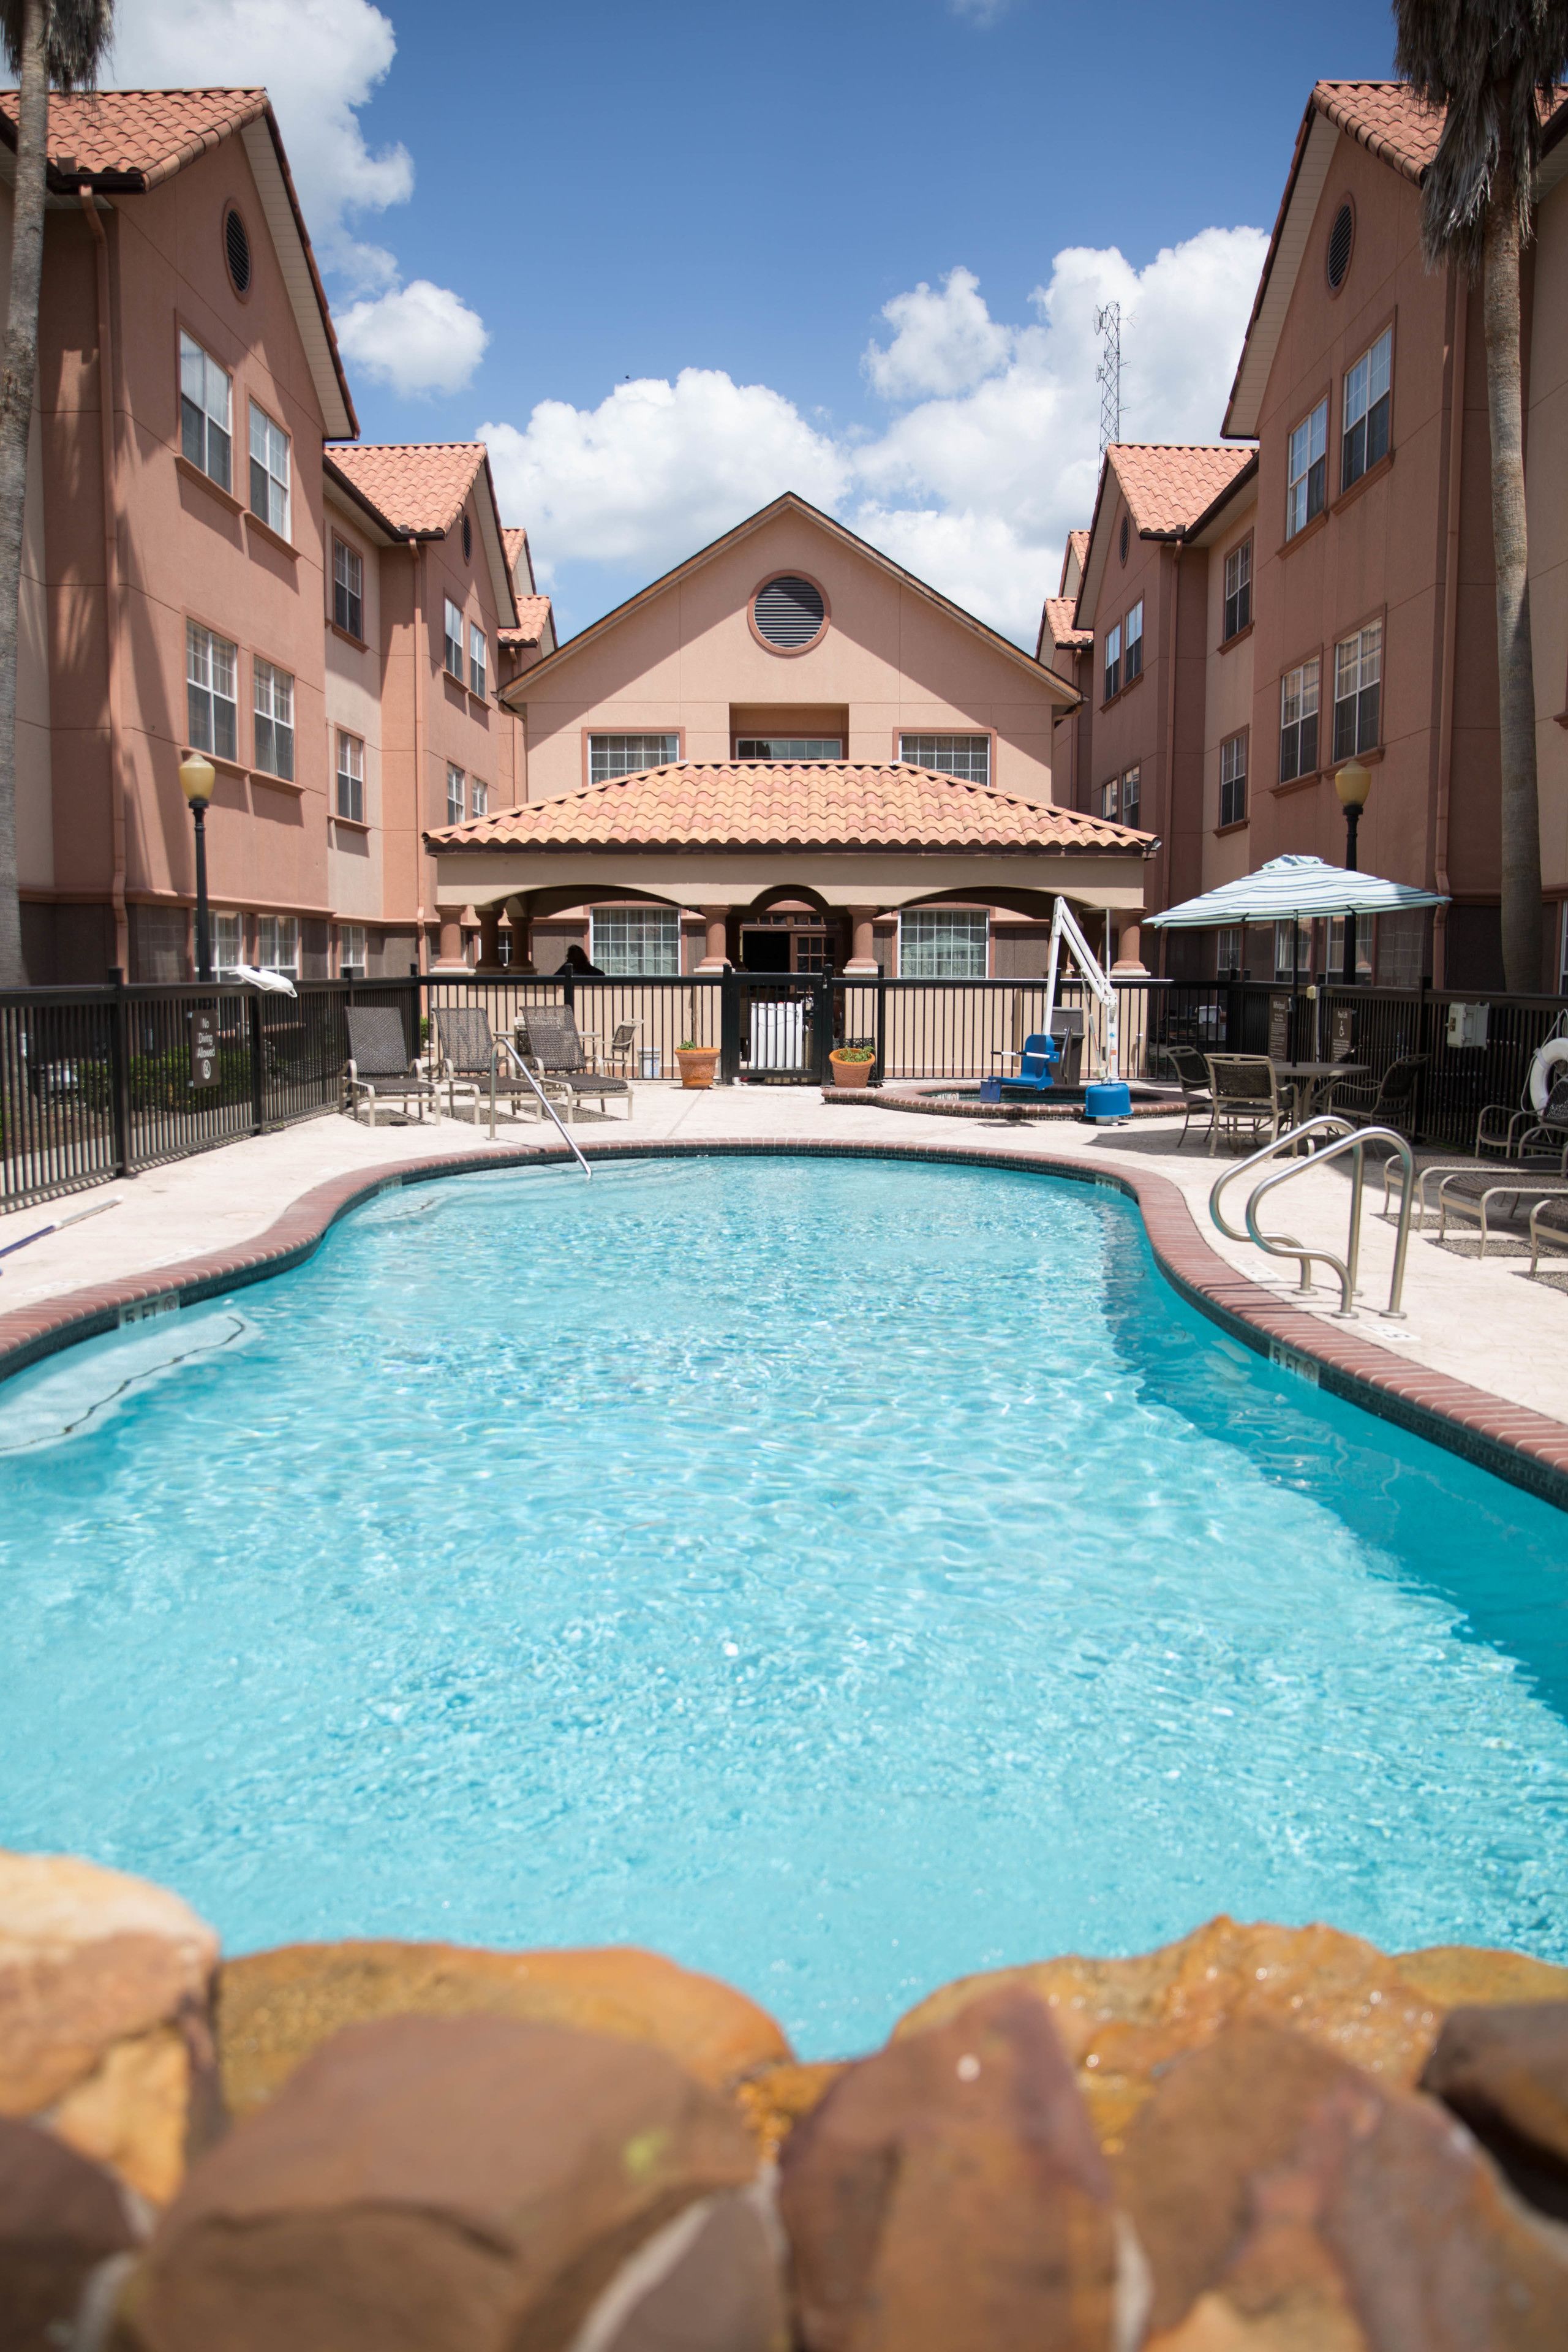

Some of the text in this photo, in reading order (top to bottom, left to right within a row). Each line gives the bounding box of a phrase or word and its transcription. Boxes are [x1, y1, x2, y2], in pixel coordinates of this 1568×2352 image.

[202, 1017, 210, 1028] No
[198, 1031, 213, 1046] Diving
[197, 1045, 216, 1058] Allowed
[142, 1300, 158, 1321] FT
[1286, 1351, 1300, 1375] FT
